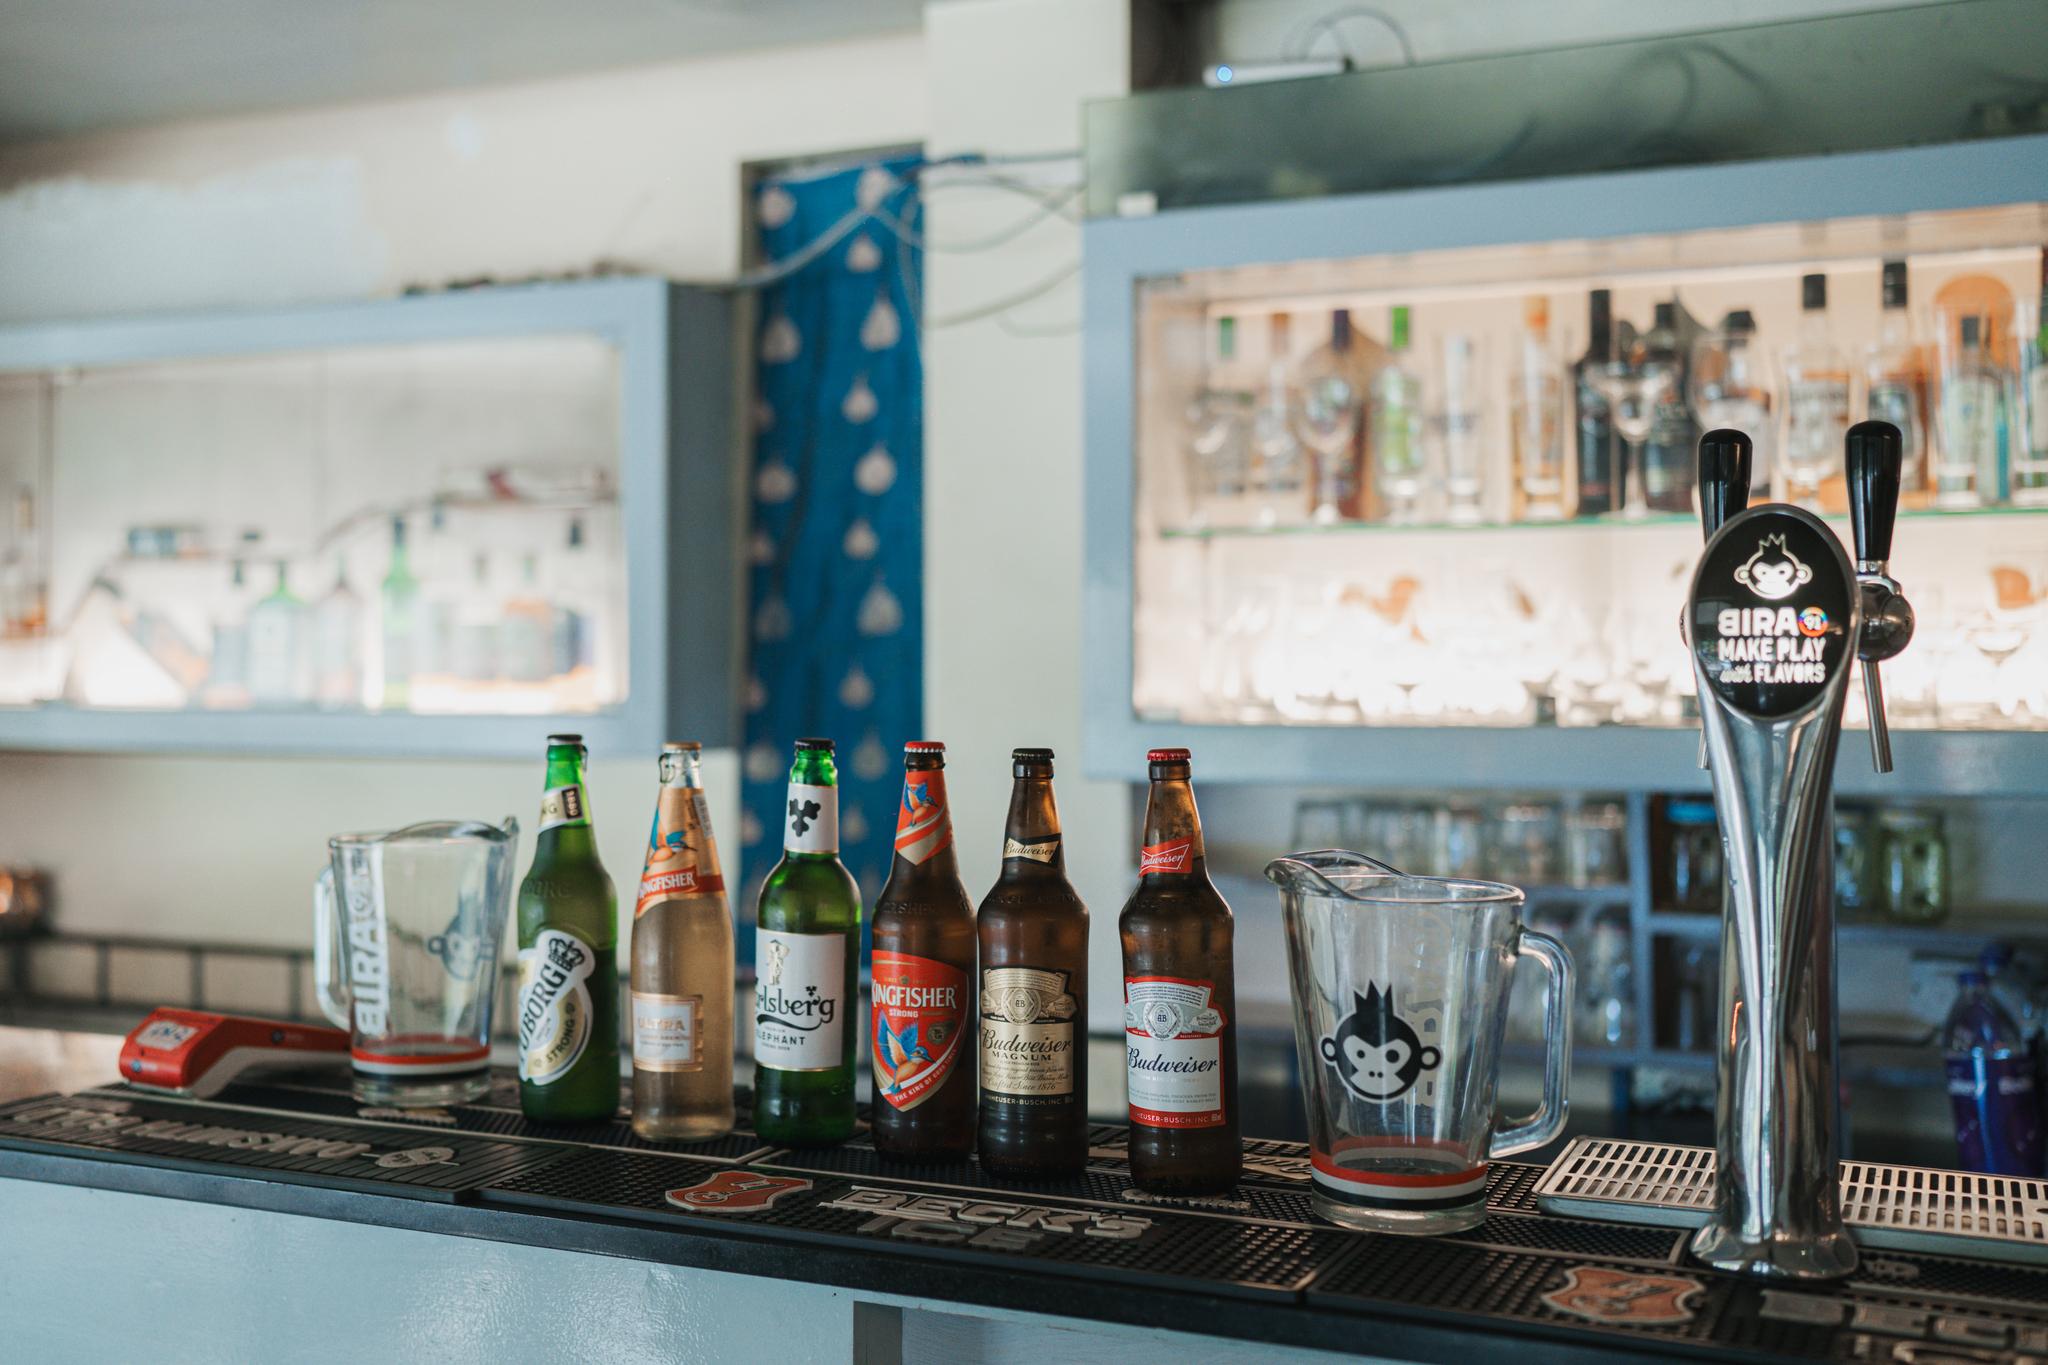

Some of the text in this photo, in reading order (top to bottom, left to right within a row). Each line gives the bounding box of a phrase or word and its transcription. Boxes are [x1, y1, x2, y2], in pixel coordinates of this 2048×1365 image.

[1718, 607, 1800, 637] BIRA
[1718, 637, 1827, 662] MAKE PLAY
[1754, 662, 1826, 684] FLAVORS
[1006, 843, 1055, 856] Budweiser
[518, 963, 568, 1064] UBORG
[888, 1008, 919, 1018] STRONG
[546, 1020, 577, 1064] STRONG
[982, 1026, 1072, 1053] Budweiser
[992, 1050, 1052, 1061] MAGNUM
[1128, 1045, 1218, 1073] Budweiser
